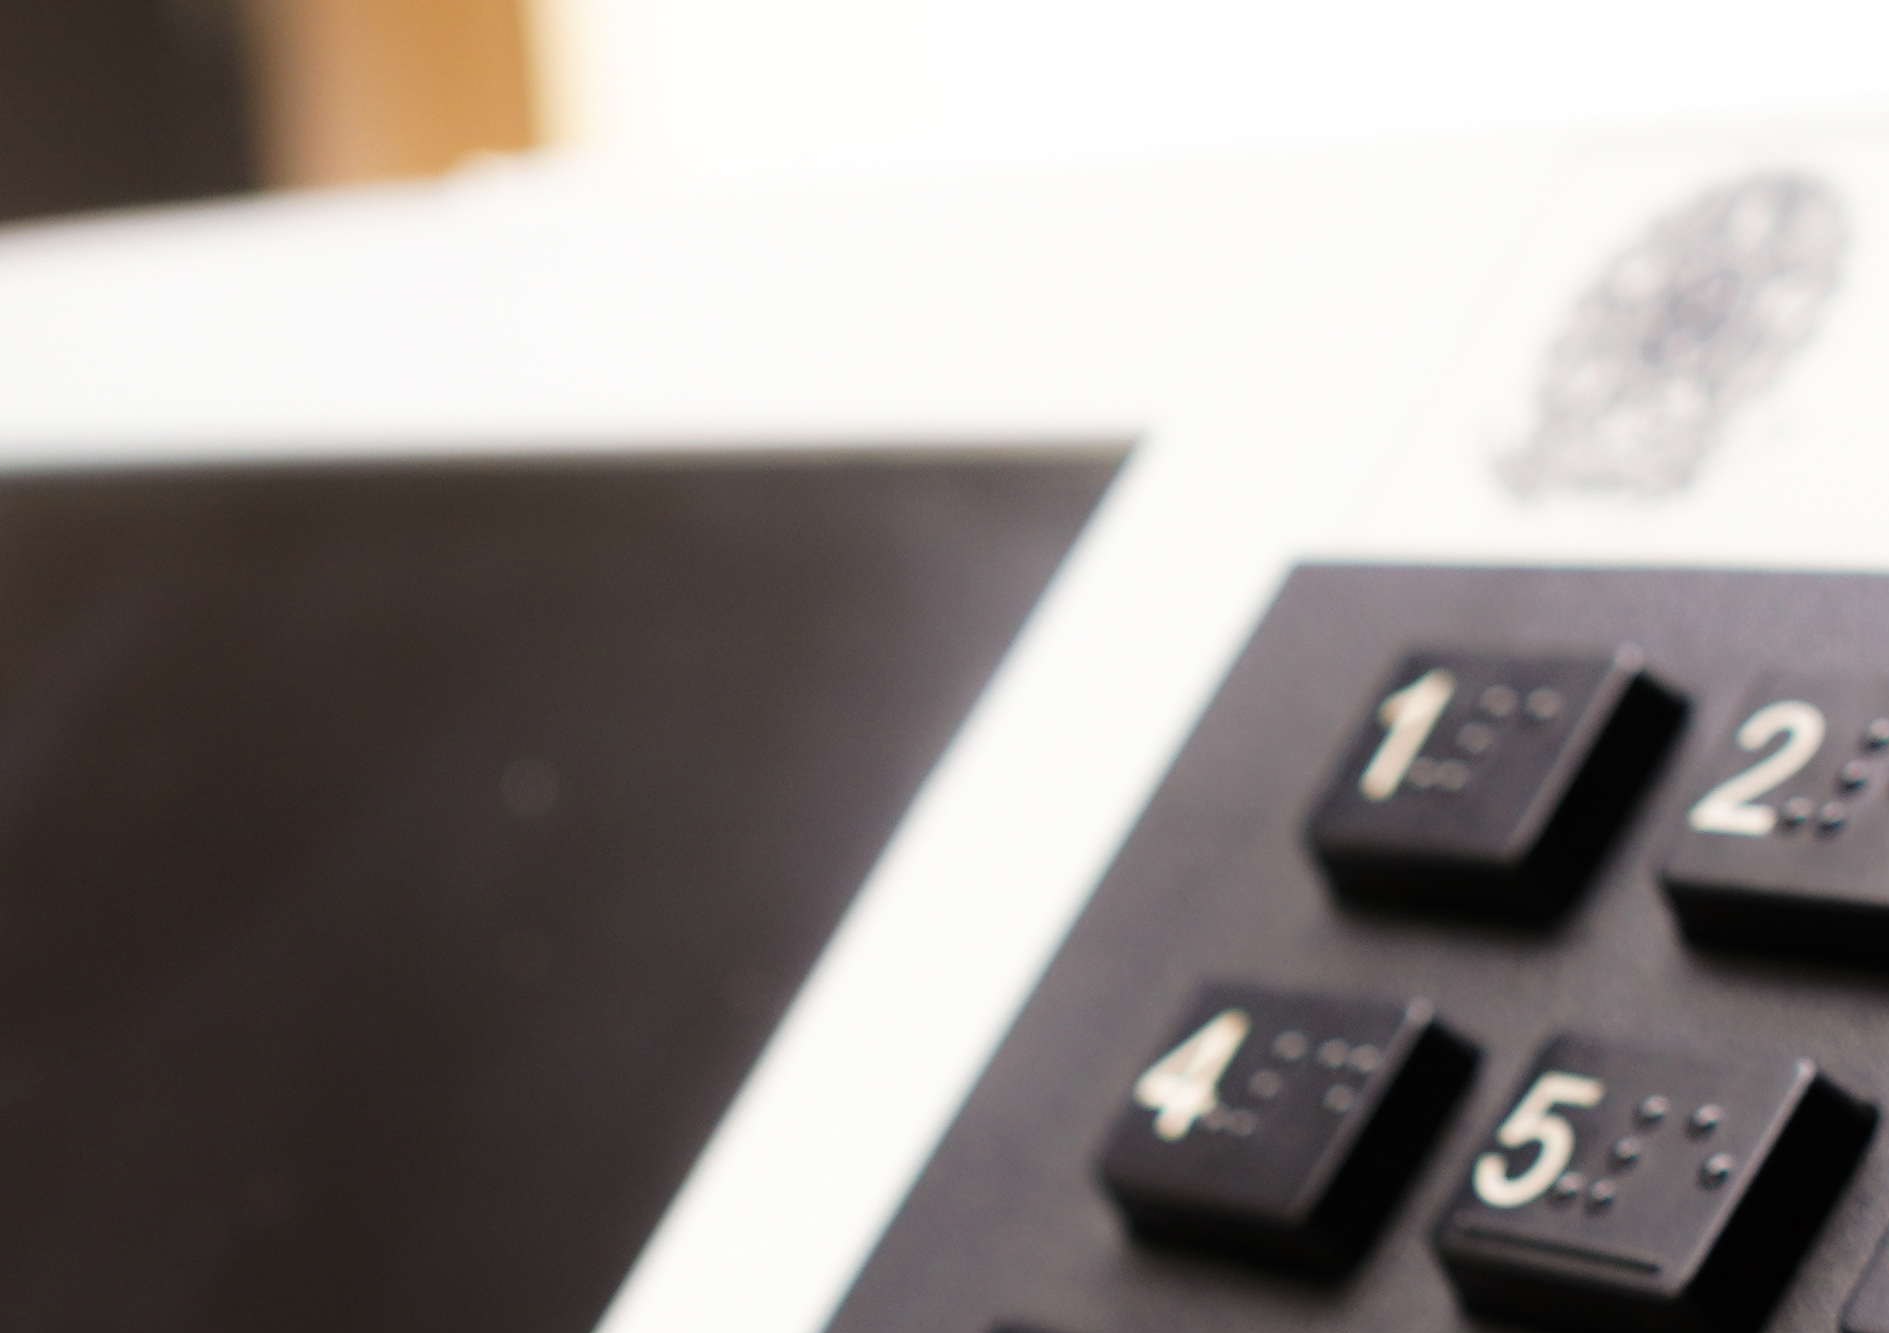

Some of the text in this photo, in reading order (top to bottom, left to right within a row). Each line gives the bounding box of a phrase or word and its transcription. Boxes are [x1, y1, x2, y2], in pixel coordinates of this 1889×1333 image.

[1359, 673, 1456, 799] 1
[1690, 700, 1822, 835] 2
[1137, 1012, 1249, 1138] 4
[1473, 1074, 1594, 1208] 5
